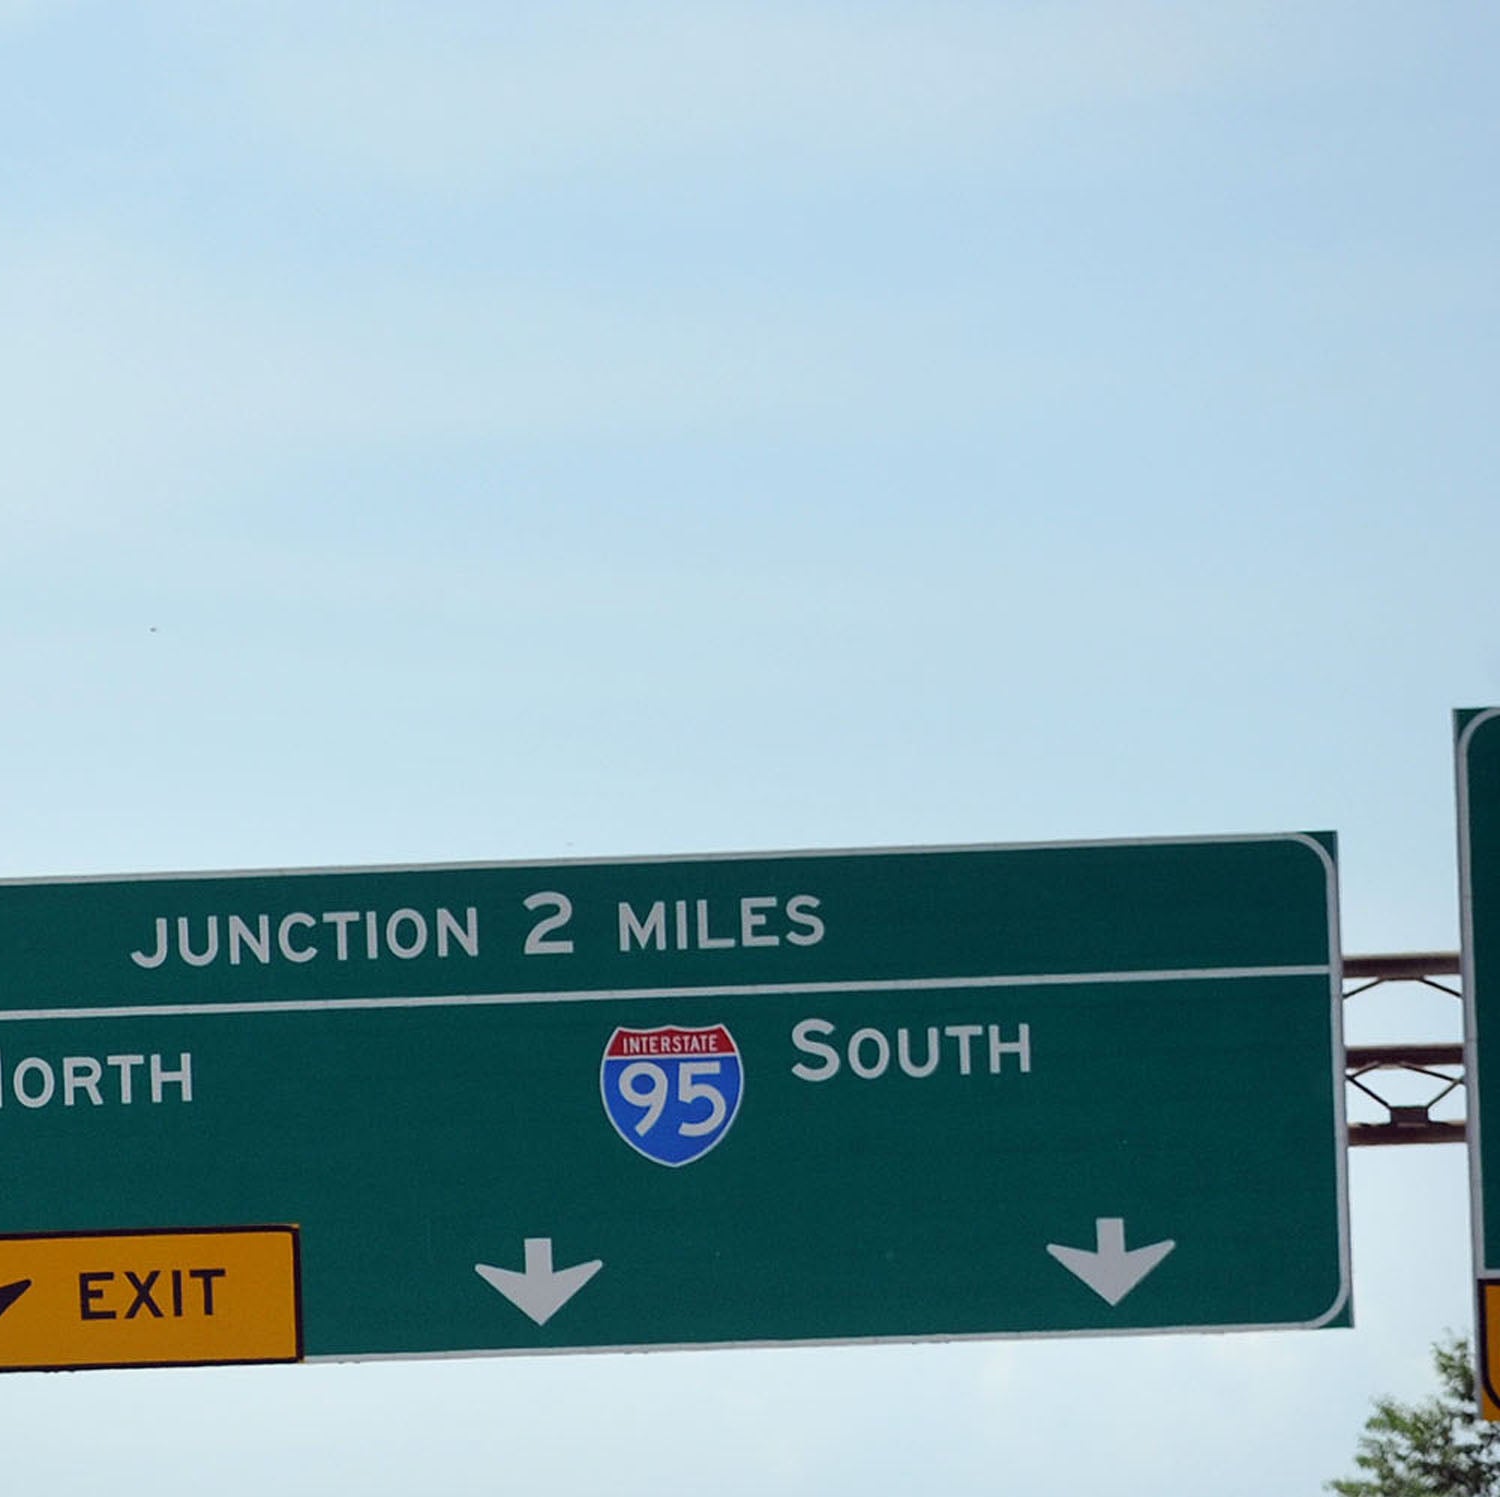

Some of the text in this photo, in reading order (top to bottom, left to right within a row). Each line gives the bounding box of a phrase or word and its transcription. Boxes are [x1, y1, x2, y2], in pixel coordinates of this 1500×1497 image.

[131, 892, 825, 968] JUNCTION 2 MILES
[621, 1031, 719, 1056] INTERSTATE
[792, 1019, 1031, 1081] SOUTH
[615, 1060, 728, 1138] 95
[79, 1268, 226, 1321] EXIT
